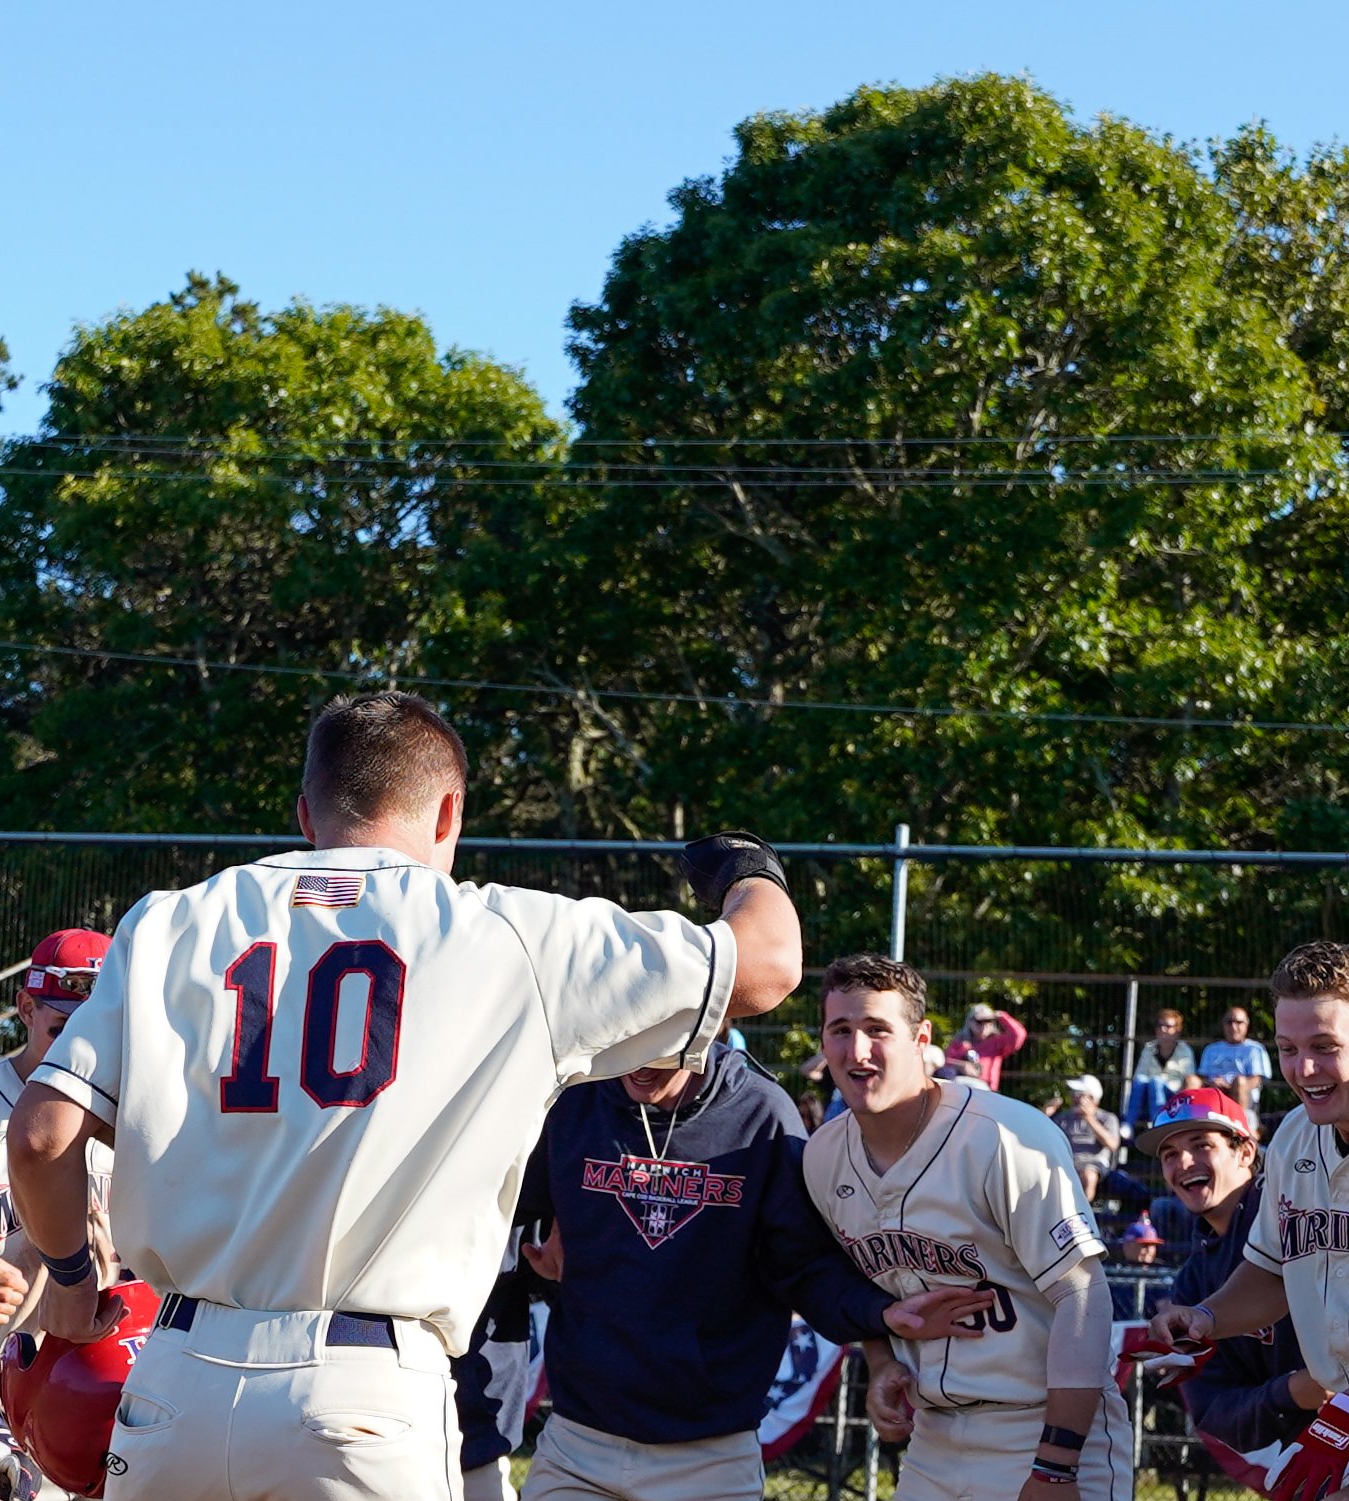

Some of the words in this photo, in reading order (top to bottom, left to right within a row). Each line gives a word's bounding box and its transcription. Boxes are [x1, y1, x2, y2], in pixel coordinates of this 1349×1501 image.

[219, 939, 407, 1114] 10
[582, 1162, 744, 1203] MARINERS
[950, 1279, 1018, 1333] 0
